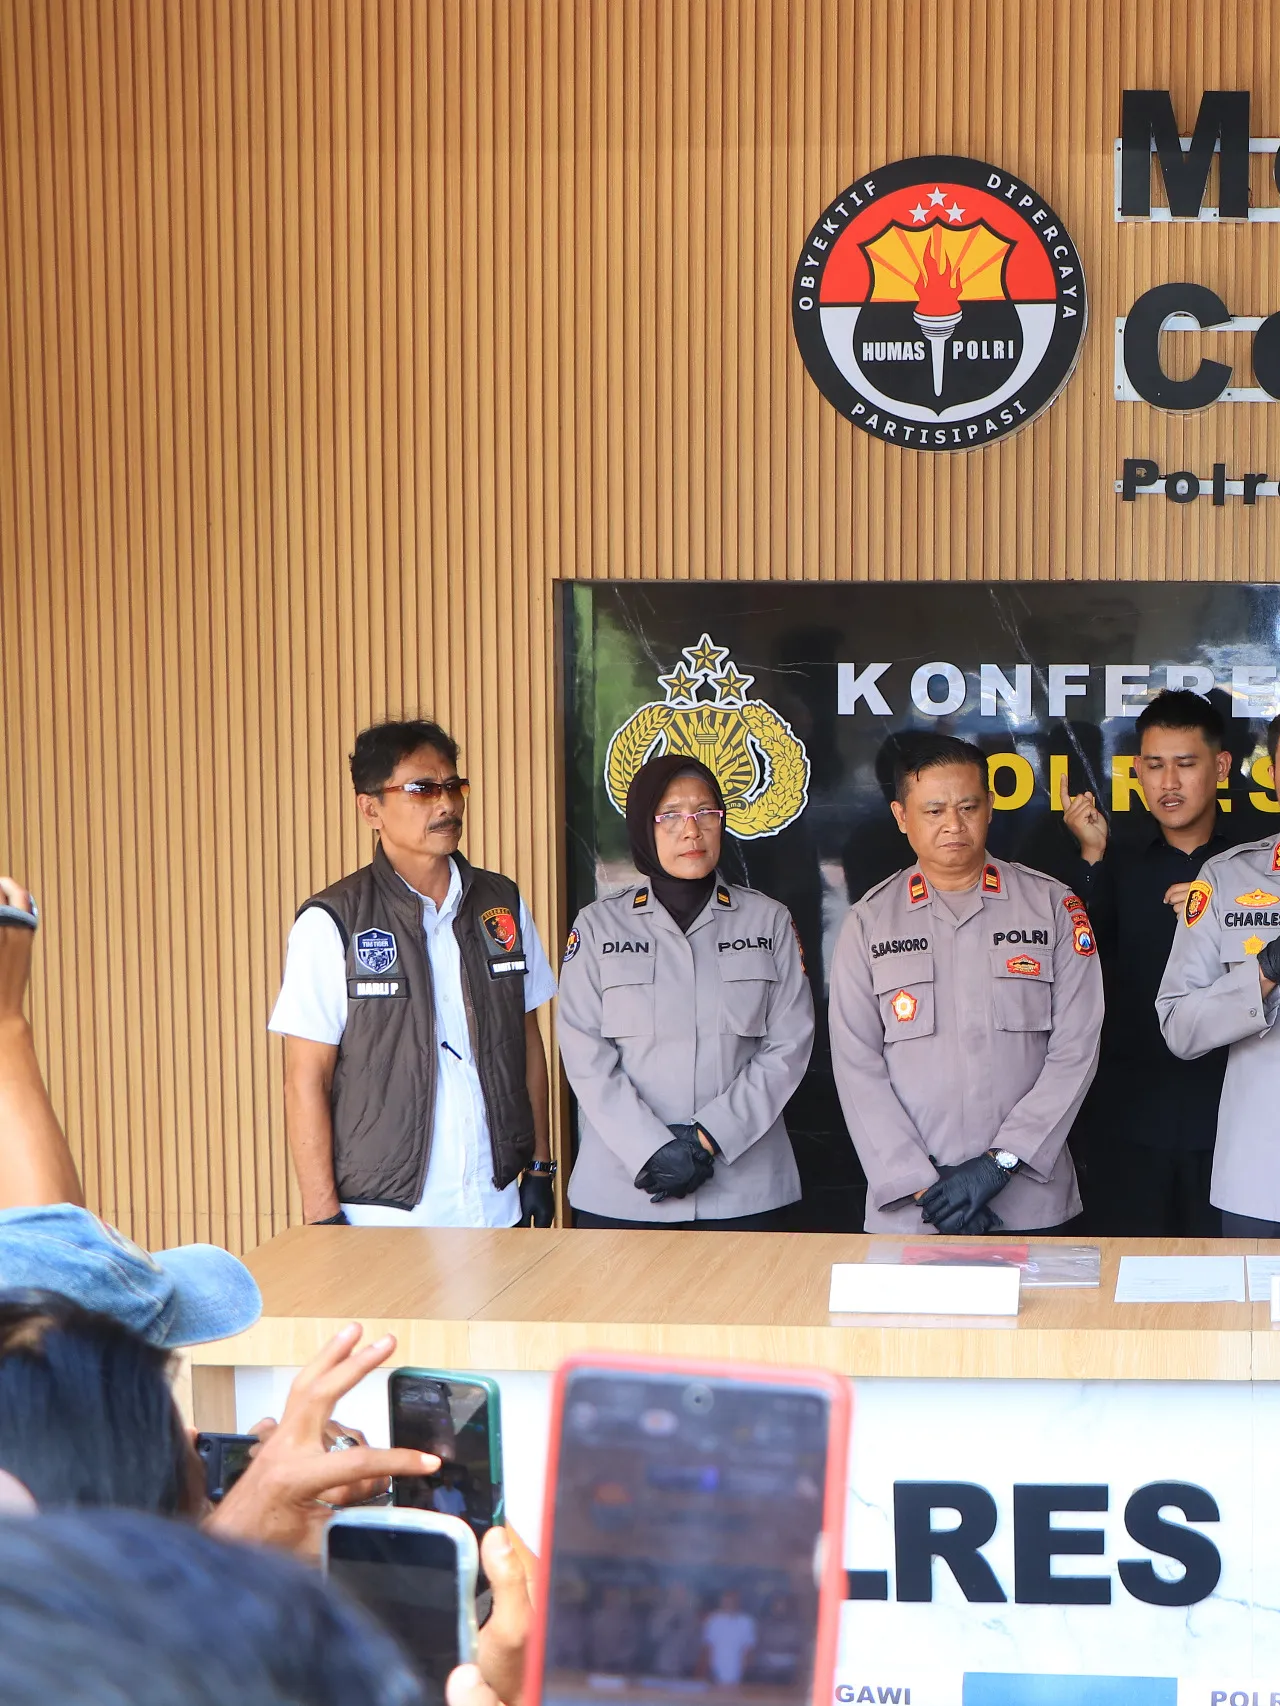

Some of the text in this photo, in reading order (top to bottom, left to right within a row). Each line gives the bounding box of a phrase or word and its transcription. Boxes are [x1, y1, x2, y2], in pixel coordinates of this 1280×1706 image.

[799, 180, 876, 311] OBYEKTIF
[986, 173, 1077, 319] DIPERCAYA
[862, 340, 1014, 361] HUMAS POLRI
[850, 399, 1027, 444] PARTISIPASI
[602, 941, 649, 955] DIAN
[718, 936, 773, 953] POLRI
[993, 930, 1048, 946] POLRI
[834, 1683, 912, 1706] GAWI
